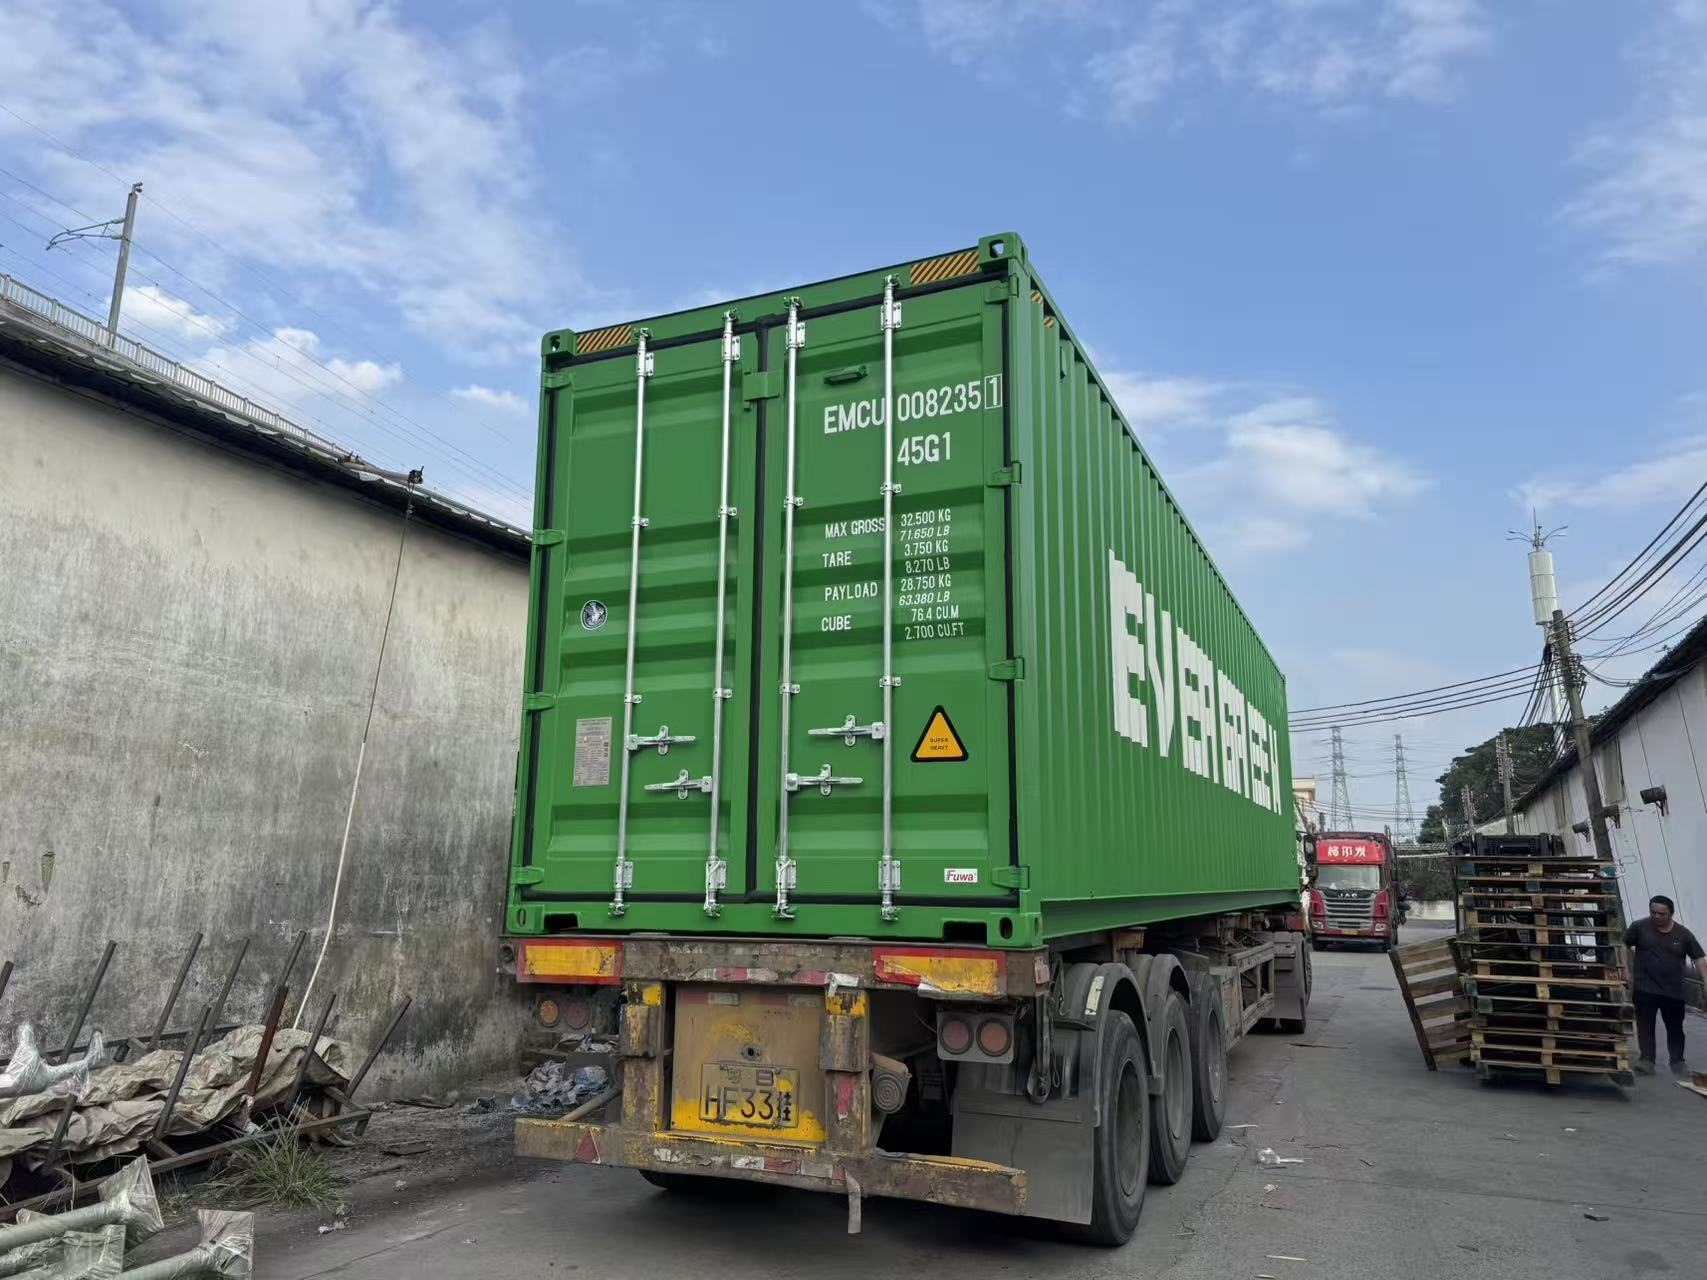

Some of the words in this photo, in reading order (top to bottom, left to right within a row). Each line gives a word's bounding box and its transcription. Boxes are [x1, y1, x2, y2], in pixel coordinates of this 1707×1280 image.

[824, 397, 885, 434] EMCU
[897, 380, 981, 422] 008235
[897, 431, 951, 466] 45G1
[901, 510, 935, 527] 32.500
[938, 508, 951, 522] KG
[825, 521, 847, 539] MAX
[851, 517, 885, 535] GROSS
[900, 527, 935, 541] 71.650
[936, 525, 950, 537] LB
[904, 541, 933, 557] 3.750
[935, 539, 949, 552] KG
[822, 550, 852, 568] TARE
[905, 558, 934, 574] 8.270
[937, 556, 950, 571] LB
[825, 581, 878, 602] PAYLOAD
[900, 576, 935, 592] 28.750
[938, 573, 951, 588] KG
[899, 592, 934, 606] 63.380
[936, 591, 951, 603] LB
[911, 607, 932, 622] 76.4
[935, 605, 959, 620] CU.M
[821, 614, 852, 632] CUBE
[905, 625, 934, 640] 2.700
[937, 622, 964, 638] CU.FT
[1108, 548, 1282, 816] EVERGREEN
[946, 869, 974, 882] Fuwa
